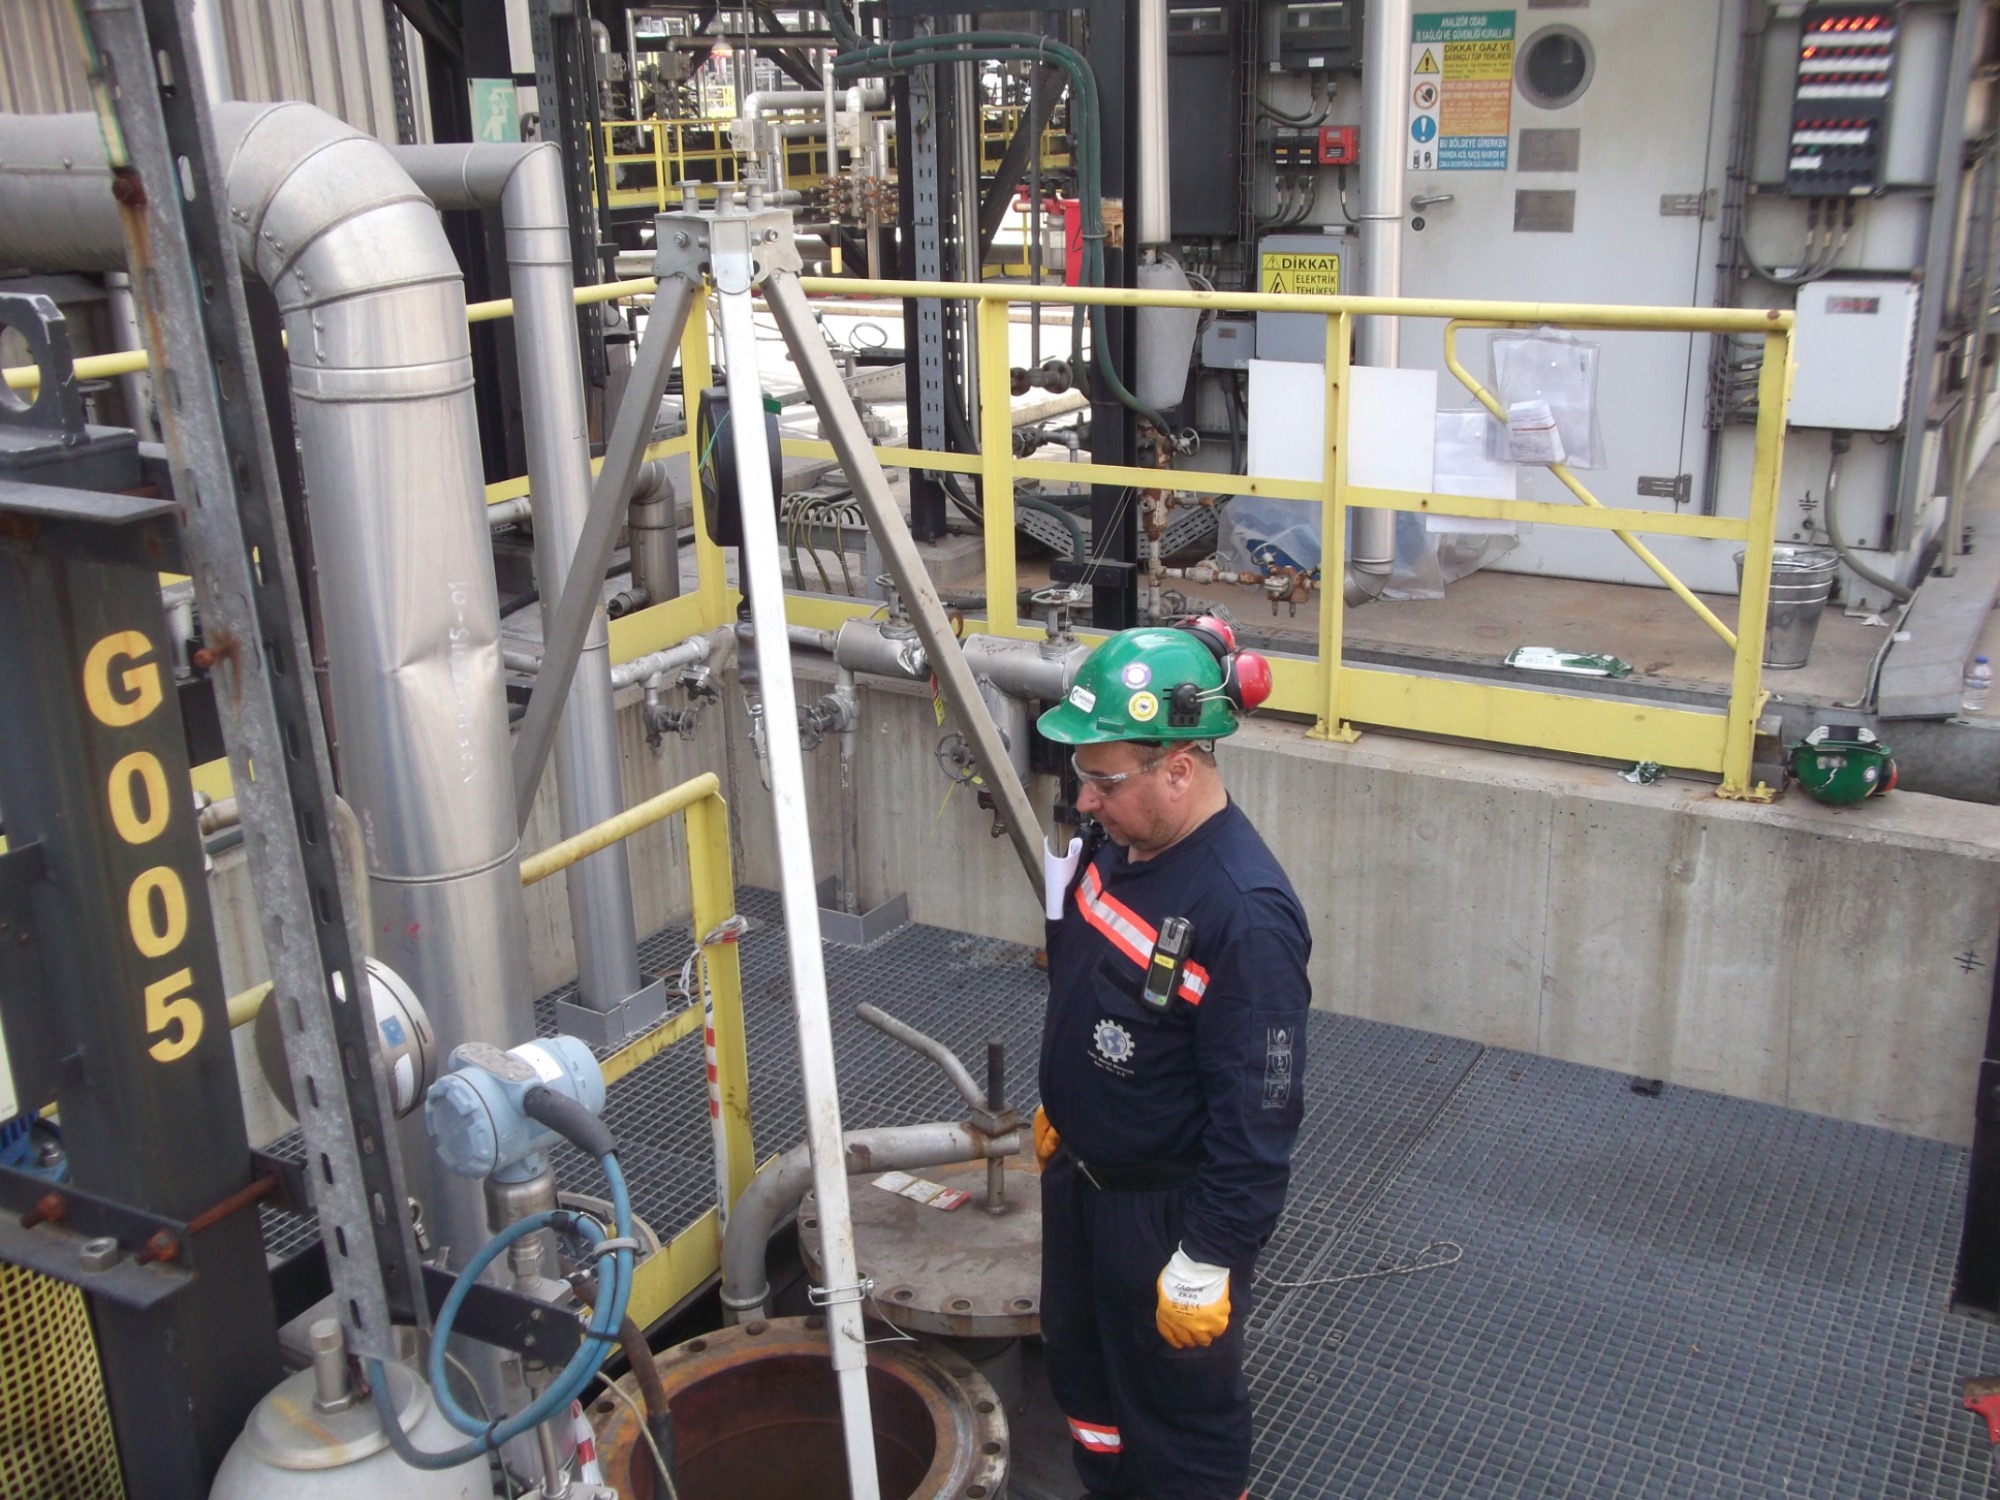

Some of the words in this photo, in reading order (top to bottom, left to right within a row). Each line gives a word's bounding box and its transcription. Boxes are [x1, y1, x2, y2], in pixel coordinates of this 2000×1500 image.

[1445, 42, 1477, 52] DİKKAT
[1479, 43, 1498, 51] GAZ
[1501, 42, 1511, 51] VE
[1440, 139, 1447, 148] BU
[1449, 138, 1476, 148] BÖLGEYE
[1282, 256, 1336, 270] DİKKAT
[1296, 273, 1336, 284] ELEKTRİK
